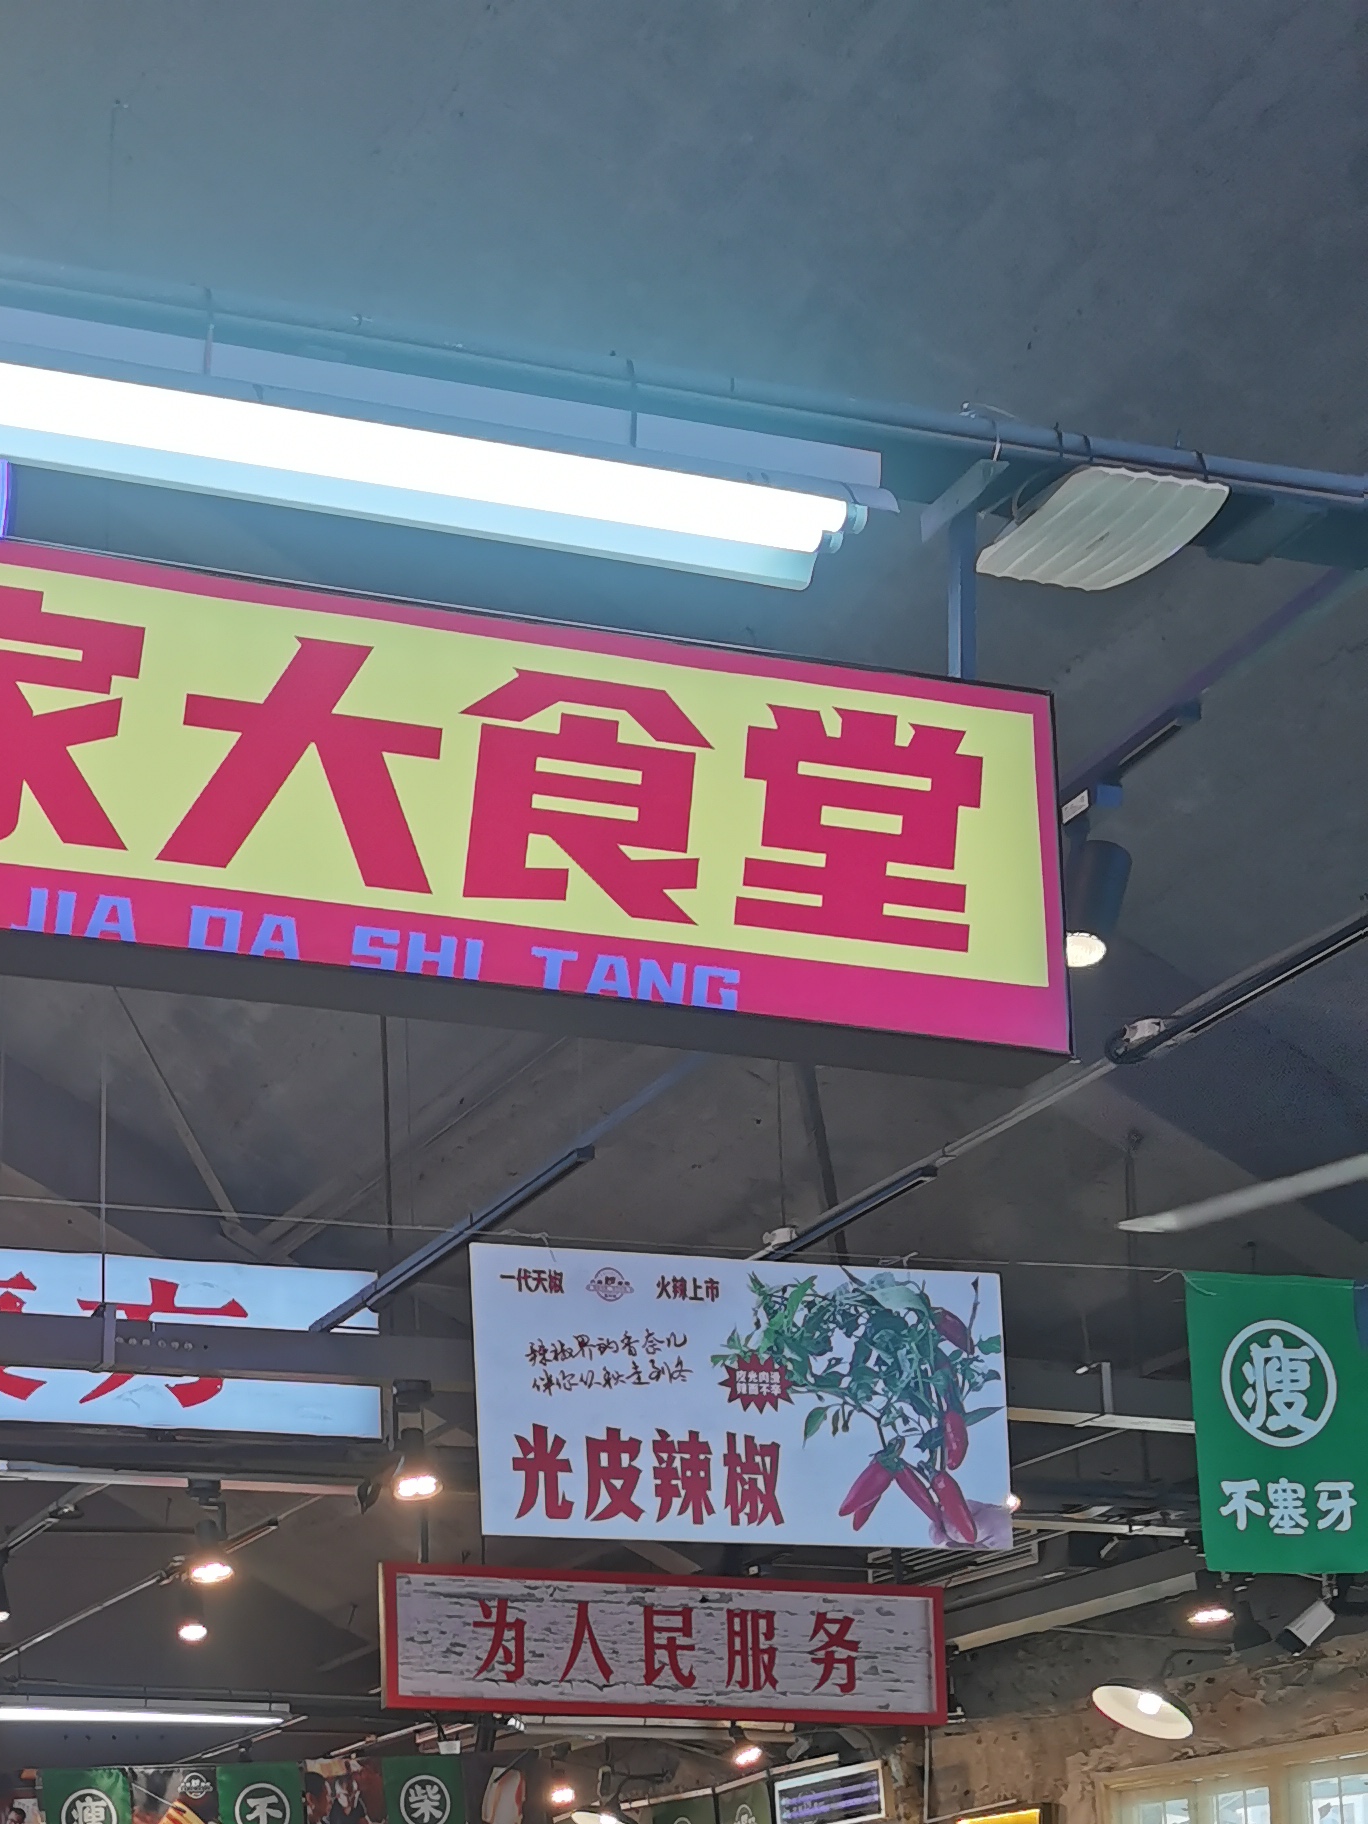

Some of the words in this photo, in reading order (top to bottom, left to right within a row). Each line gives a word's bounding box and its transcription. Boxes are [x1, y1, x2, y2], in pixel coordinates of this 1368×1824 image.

[11, 887, 138, 942] JIA
[188, 905, 300, 960] DA
[350, 926, 484, 979] SHI
[531, 946, 742, 1011] TANG
[500, 1268, 565, 1294] 一代天椒
[655, 1275, 720, 1302] 火辣上市
[1241, 1334, 1317, 1432] 瘦
[512, 1423, 785, 1528] 光皮辣椒
[1219, 1478, 1358, 1535] 不塞牙
[472, 1597, 861, 1696] 为人民服务
[408, 1785, 442, 1824] 柴
